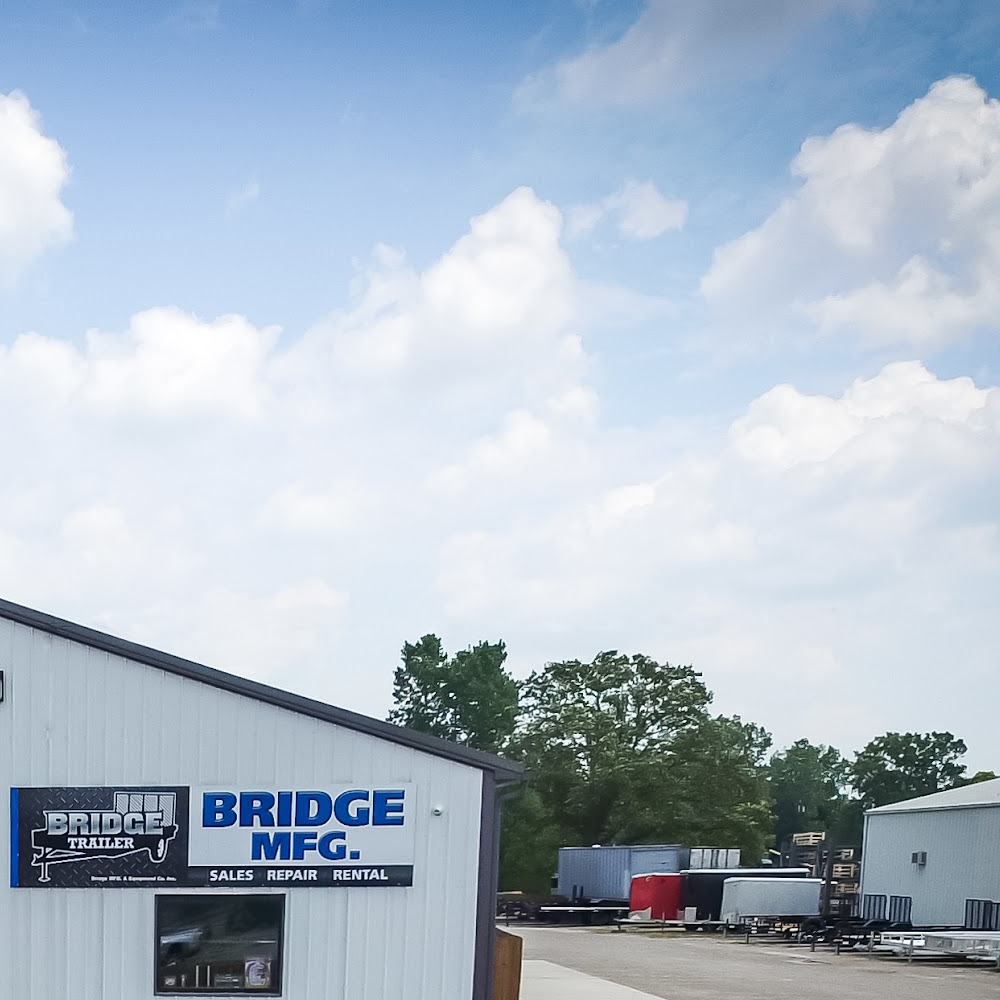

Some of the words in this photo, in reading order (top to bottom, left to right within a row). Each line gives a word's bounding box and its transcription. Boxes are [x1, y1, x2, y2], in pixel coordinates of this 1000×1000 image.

[202, 789, 405, 828] BRIDGE
[47, 812, 164, 836] BRIDGE
[67, 837, 135, 849] TRAILER
[251, 831, 360, 861] MFG.
[209, 870, 254, 881] SALES
[266, 869, 318, 881] REPAIR
[332, 869, 388, 881] RENTAL
